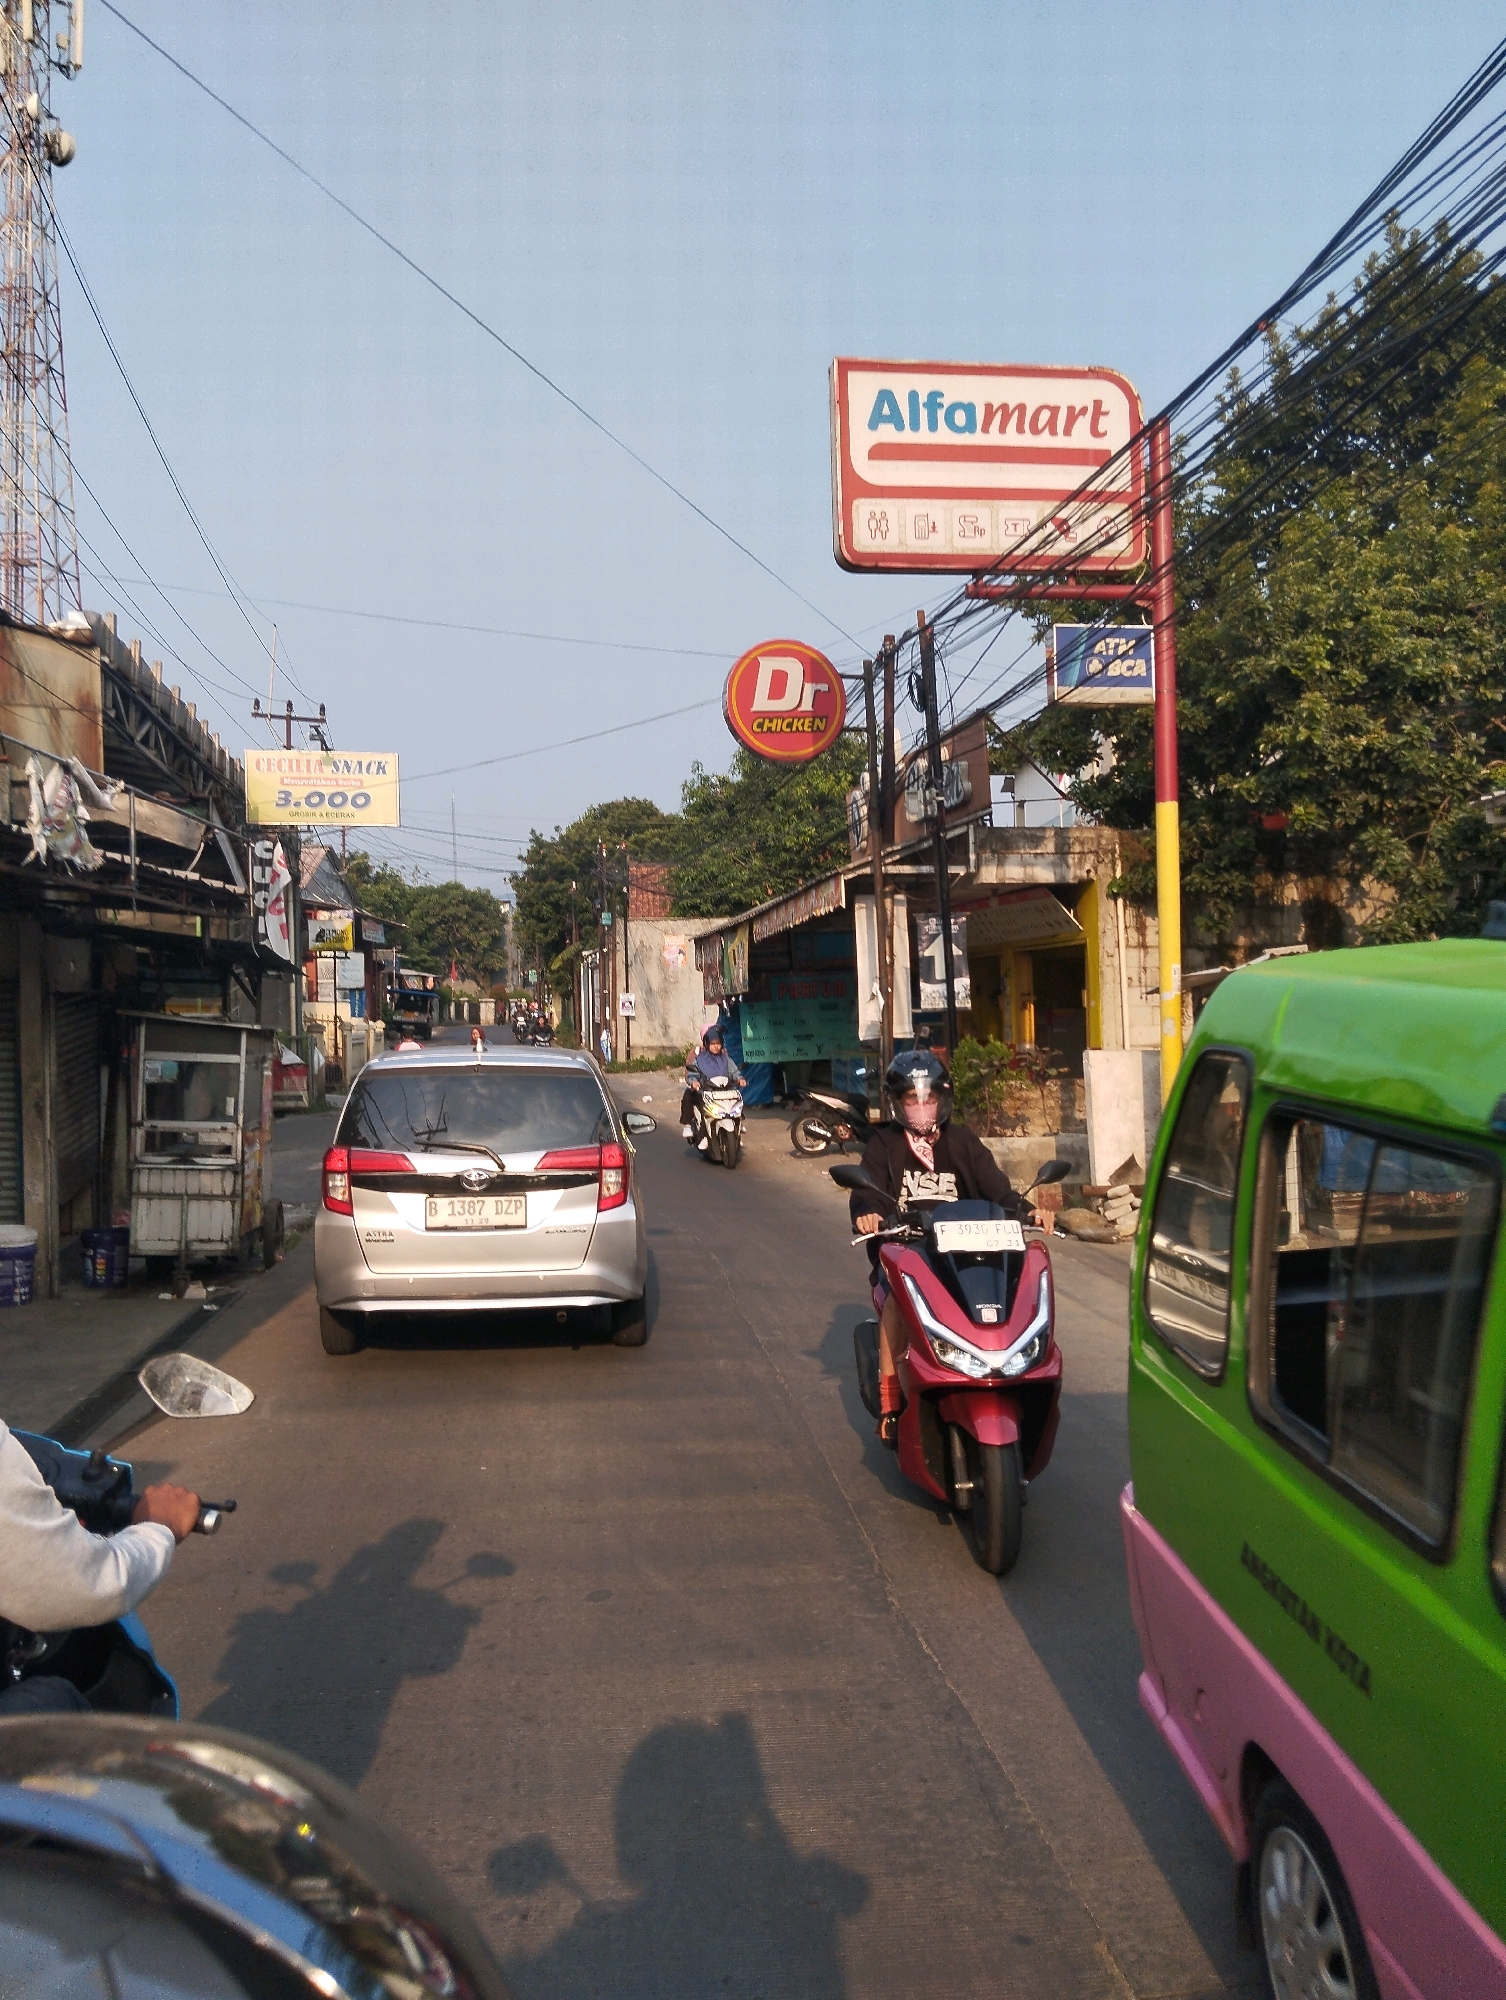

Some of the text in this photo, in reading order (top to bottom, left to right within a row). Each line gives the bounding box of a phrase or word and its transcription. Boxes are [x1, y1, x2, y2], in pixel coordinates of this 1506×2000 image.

[867, 388, 1110, 438] Alfamart
[1093, 637, 1136, 656] ATM
[1107, 658, 1147, 677] BCA
[750, 656, 829, 712] Dr
[752, 717, 828, 733] CHICKEN
[255, 757, 389, 776] CECILIA SNACK
[275, 789, 372, 810] 3.000
[779, 980, 847, 1000] PARFUM
[428, 1199, 523, 1217] B 1387 DZP
